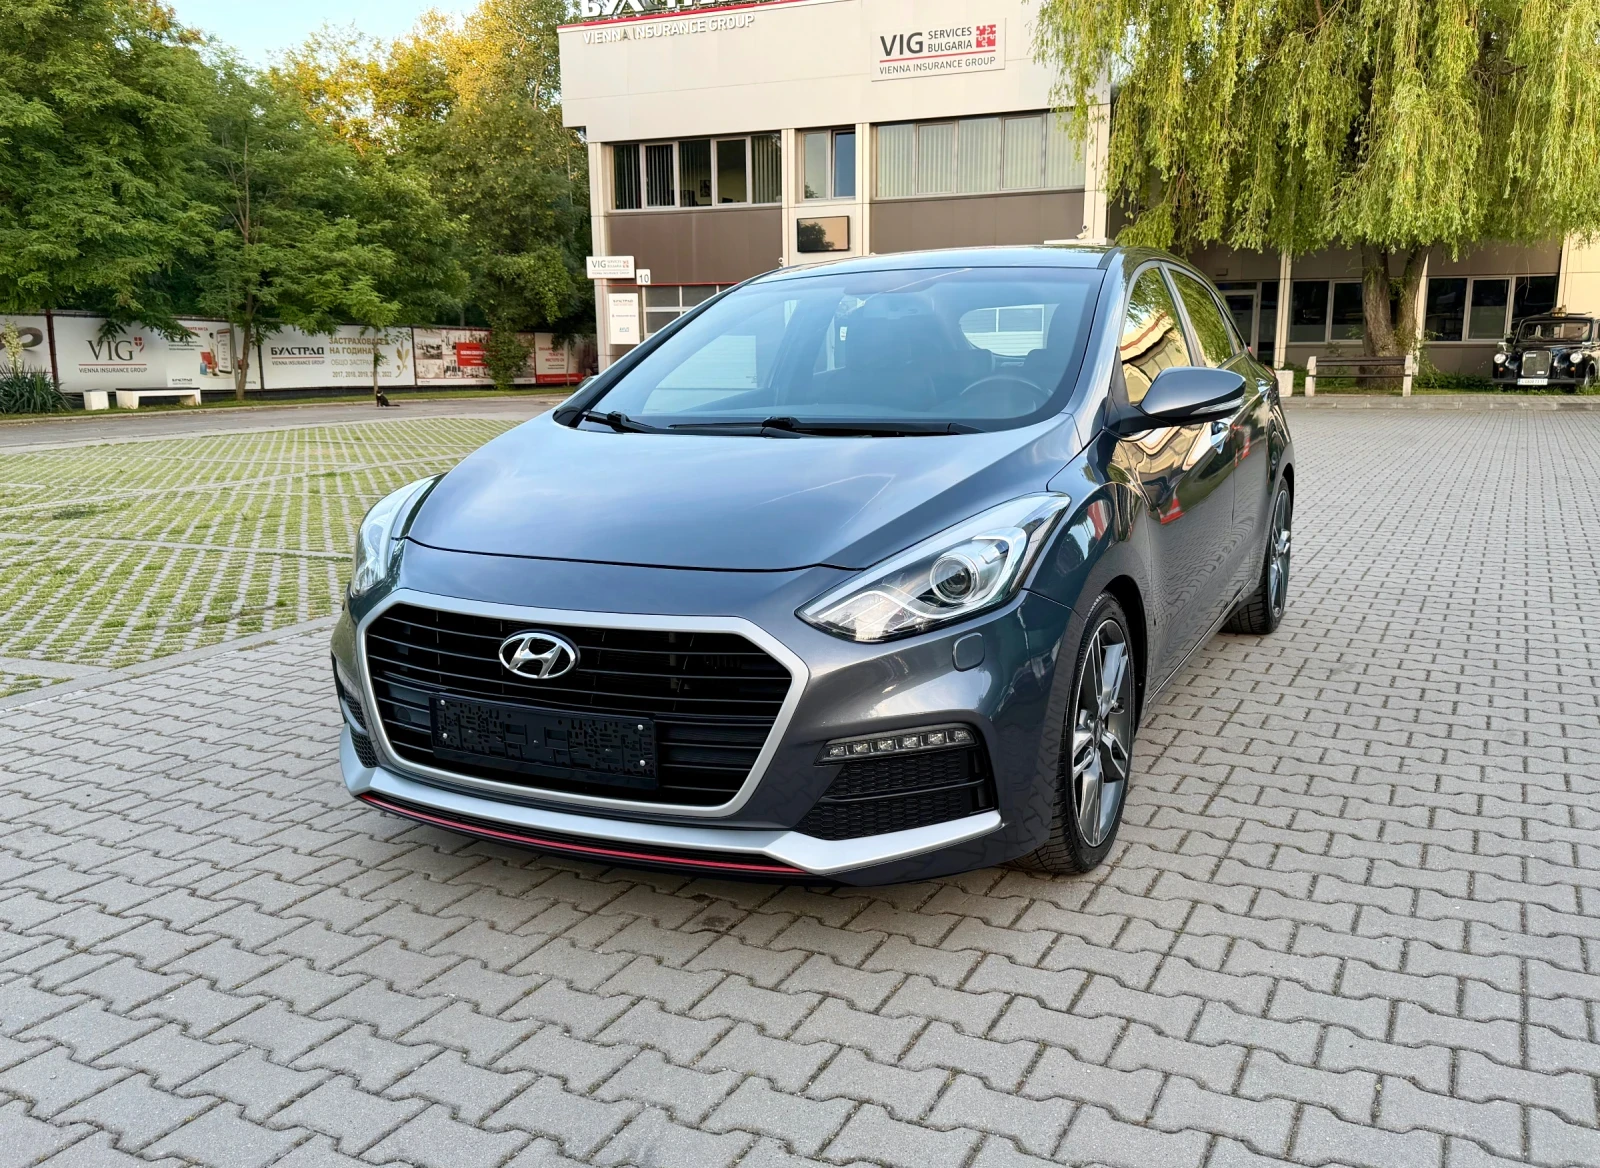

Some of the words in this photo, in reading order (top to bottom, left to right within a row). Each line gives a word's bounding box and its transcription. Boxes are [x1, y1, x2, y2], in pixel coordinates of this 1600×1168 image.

[583, 30, 631, 44] VIENNA
[633, 21, 706, 40] INSURANCE
[708, 14, 755, 31] GROUP
[928, 27, 972, 40] SERVICES
[880, 32, 924, 56] VIG
[928, 40, 972, 53] BULGARIA
[880, 64, 911, 75] VIENNA
[913, 59, 963, 72] INSURANCE
[965, 56, 996, 67] GROUP
[592, 260, 606, 268] VIG
[639, 274, 649, 283] 10
[86, 340, 134, 361] VIG
[270, 346, 324, 356] БУЛСТРАД
[329, 347, 340, 355] НА
